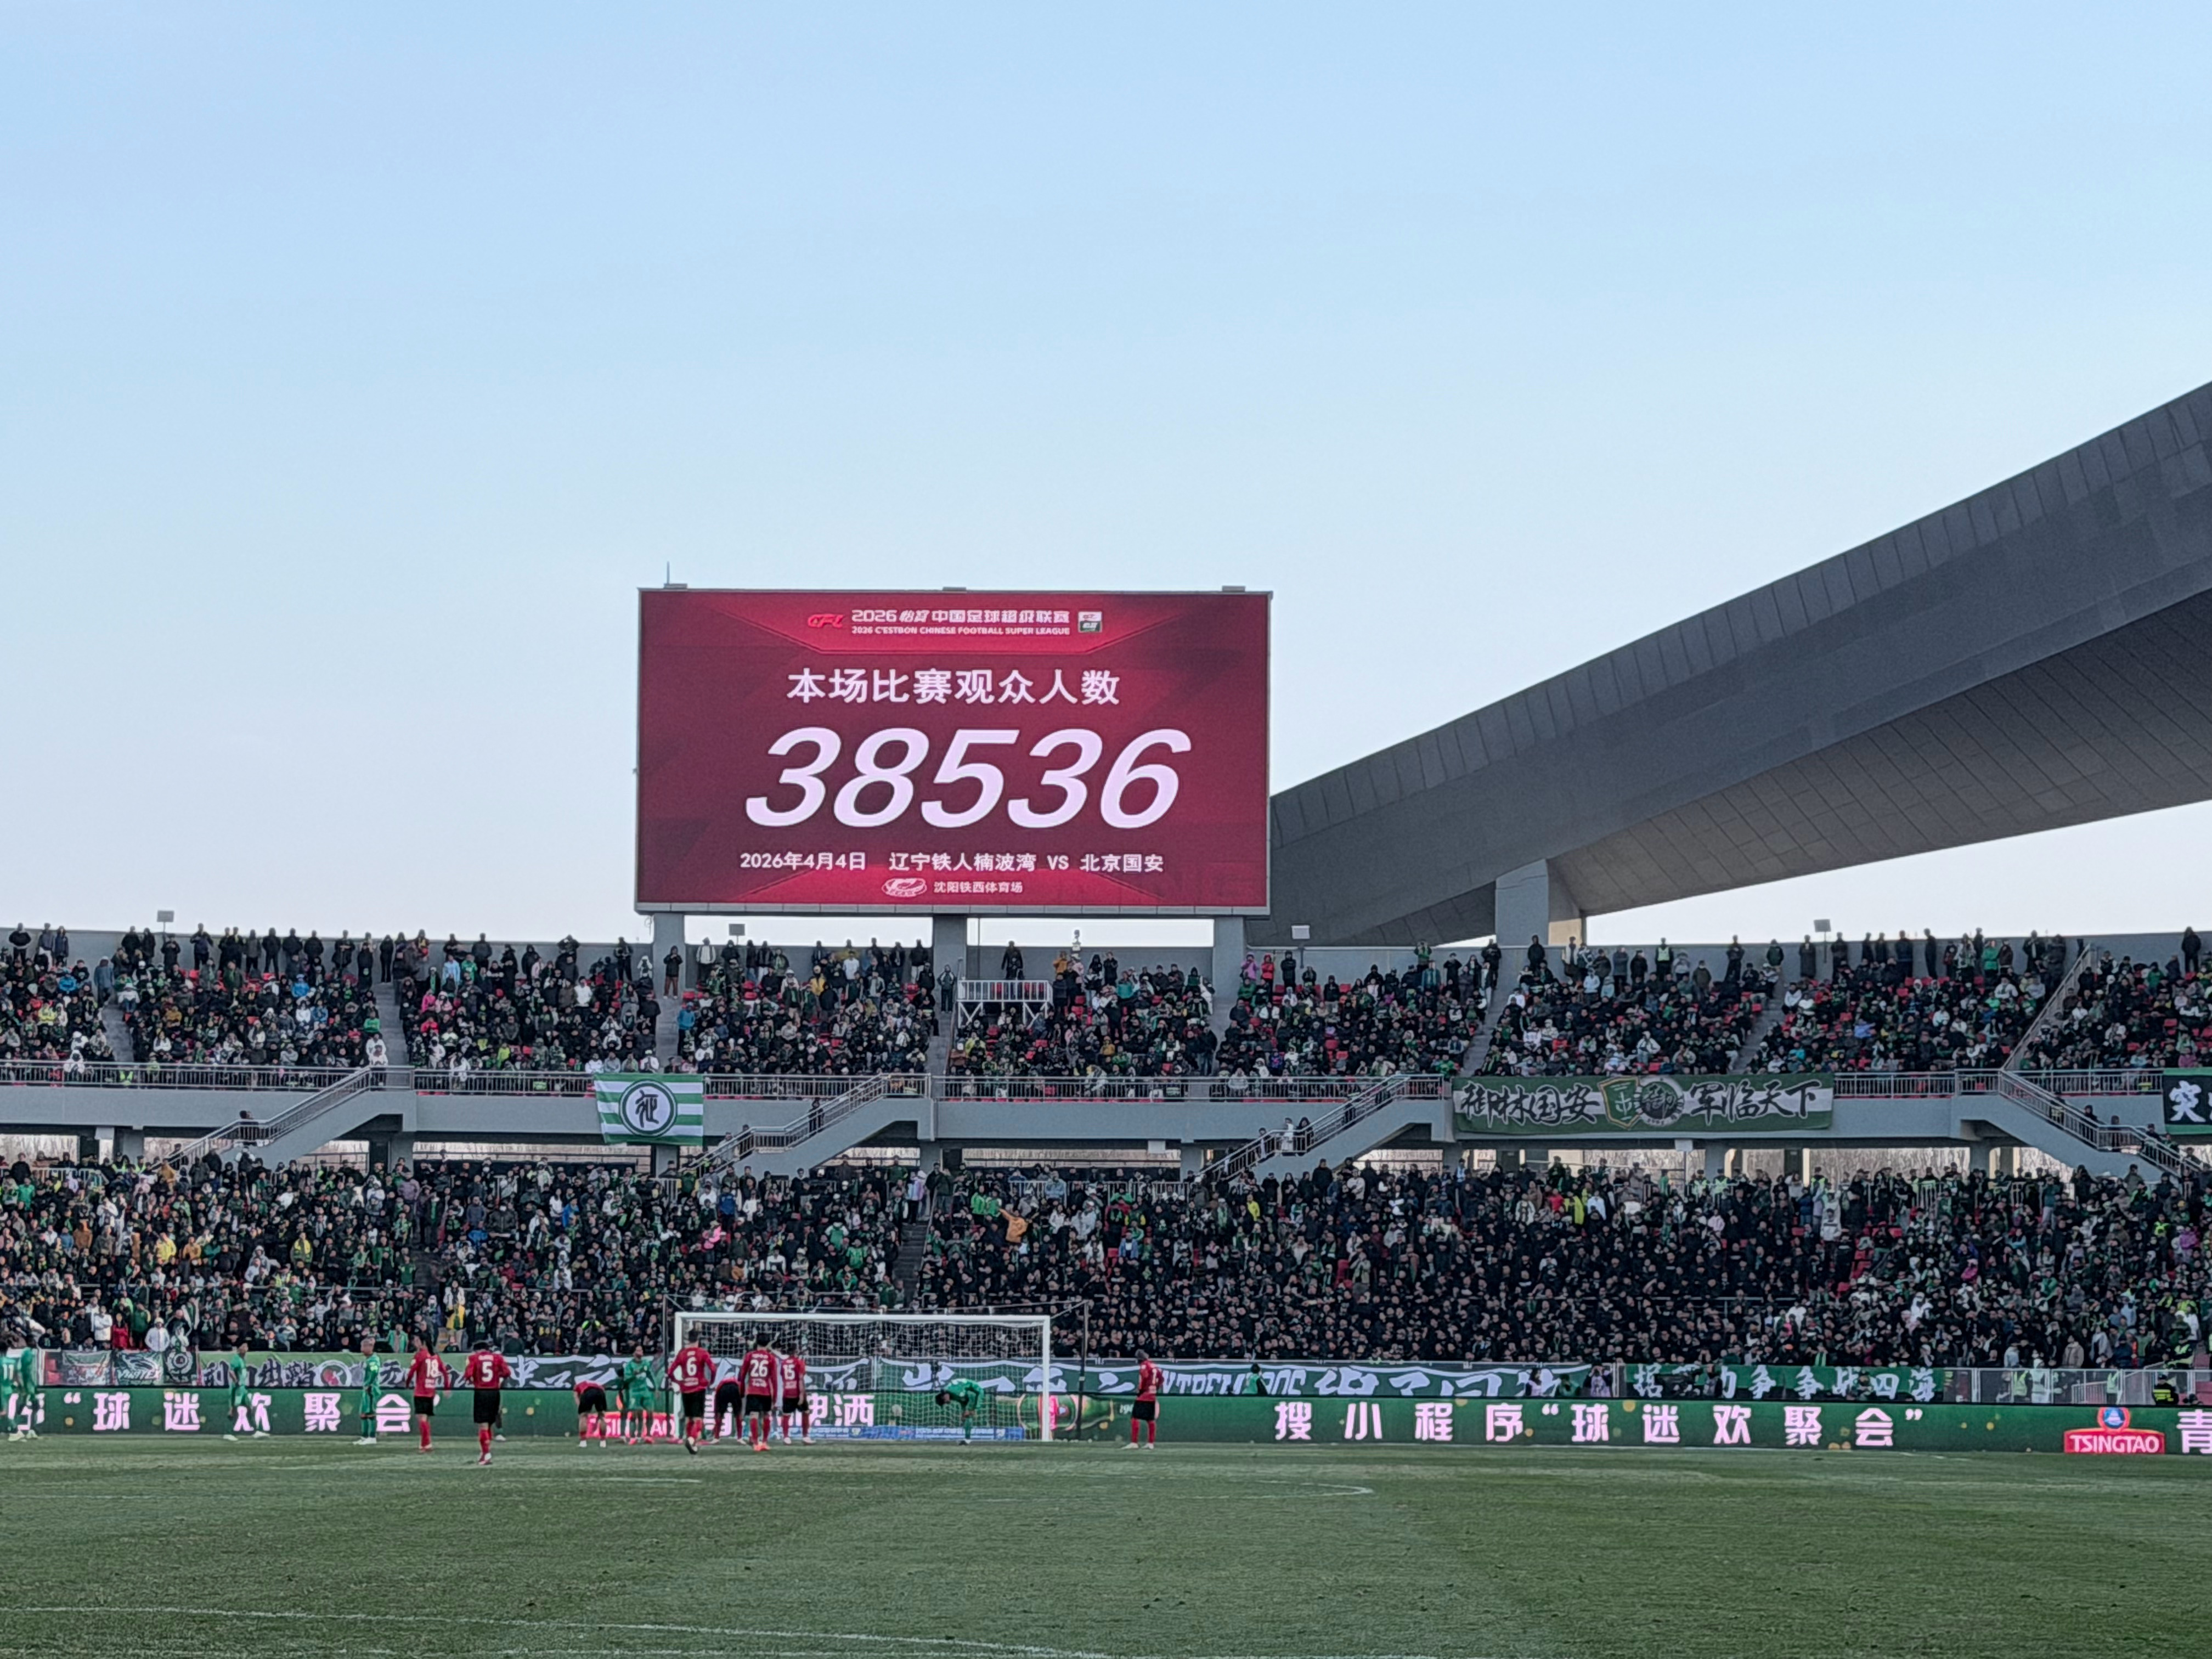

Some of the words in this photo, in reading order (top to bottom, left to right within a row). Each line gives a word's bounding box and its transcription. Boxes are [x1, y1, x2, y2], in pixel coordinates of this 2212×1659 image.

[851, 626, 873, 634] 2026
[919, 626, 956, 635] CHINESE
[957, 626, 1003, 635] FOOTBALL
[1005, 626, 1034, 635] SUPER
[1035, 627, 1070, 635] LEAGUE
[787, 668, 1120, 705] 本场比赛观众人数
[745, 727, 1192, 829] 38536
[740, 851, 866, 871] 2026年4月4日
[889, 851, 1036, 872] 辽宁铁人楠波湾
[1047, 854, 1069, 871] VS
[1080, 853, 1164, 873] 北京国安
[934, 881, 1023, 893] 沈阳铁西体育场
[425, 1358, 439, 1378] 18
[482, 1361, 493, 1383] 5
[687, 1357, 697, 1376] 6
[751, 1359, 769, 1377] 26
[2069, 1435, 2159, 1453] TSINGTAO
